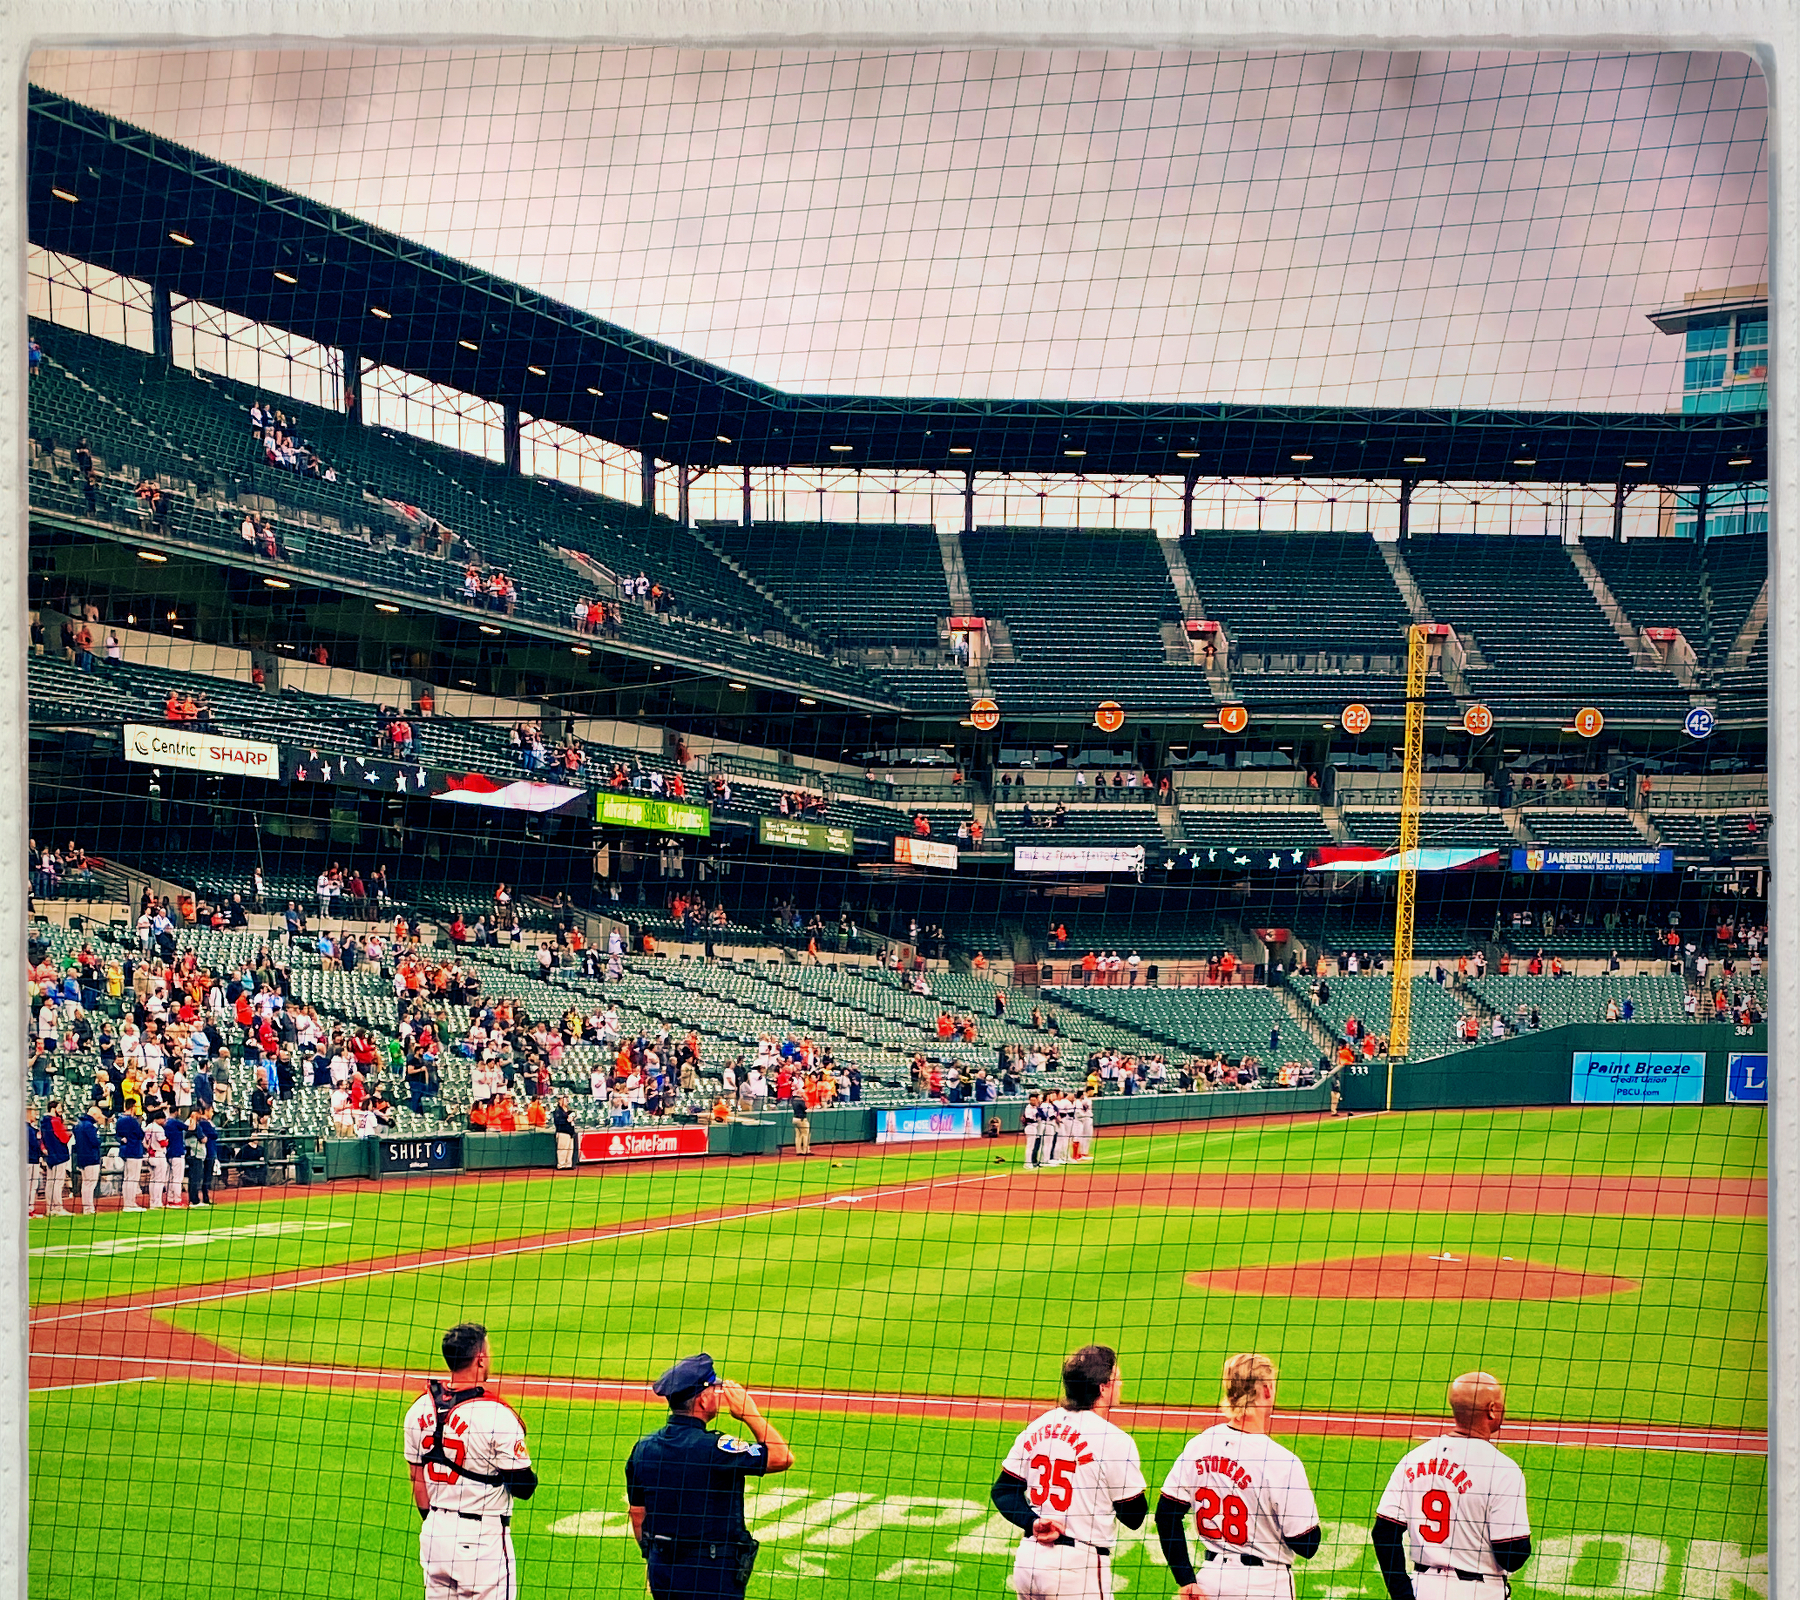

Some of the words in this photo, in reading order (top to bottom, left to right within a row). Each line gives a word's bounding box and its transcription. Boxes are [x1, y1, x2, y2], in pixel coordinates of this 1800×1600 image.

[1227, 709, 1238, 725] 4
[1346, 710, 1366, 727] 22
[1469, 712, 1489, 728] 33
[1585, 714, 1595, 731] 8
[1689, 714, 1710, 732] 42
[152, 737, 196, 757] Centric
[209, 746, 268, 766] SHARP
[1612, 852, 1660, 864] FURNITURE
[1734, 1025, 1754, 1036] 384
[1350, 1065, 1369, 1076] 333
[1635, 1062, 1690, 1075] Breeze
[1610, 1074, 1638, 1083] Credit
[1616, 1088, 1660, 1096] PBCU.com
[1029, 1453, 1077, 1512] 35
[1405, 1457, 1473, 1495] SANDERS
[1194, 1486, 1249, 1546] 28
[1418, 1488, 1451, 1545] 9
